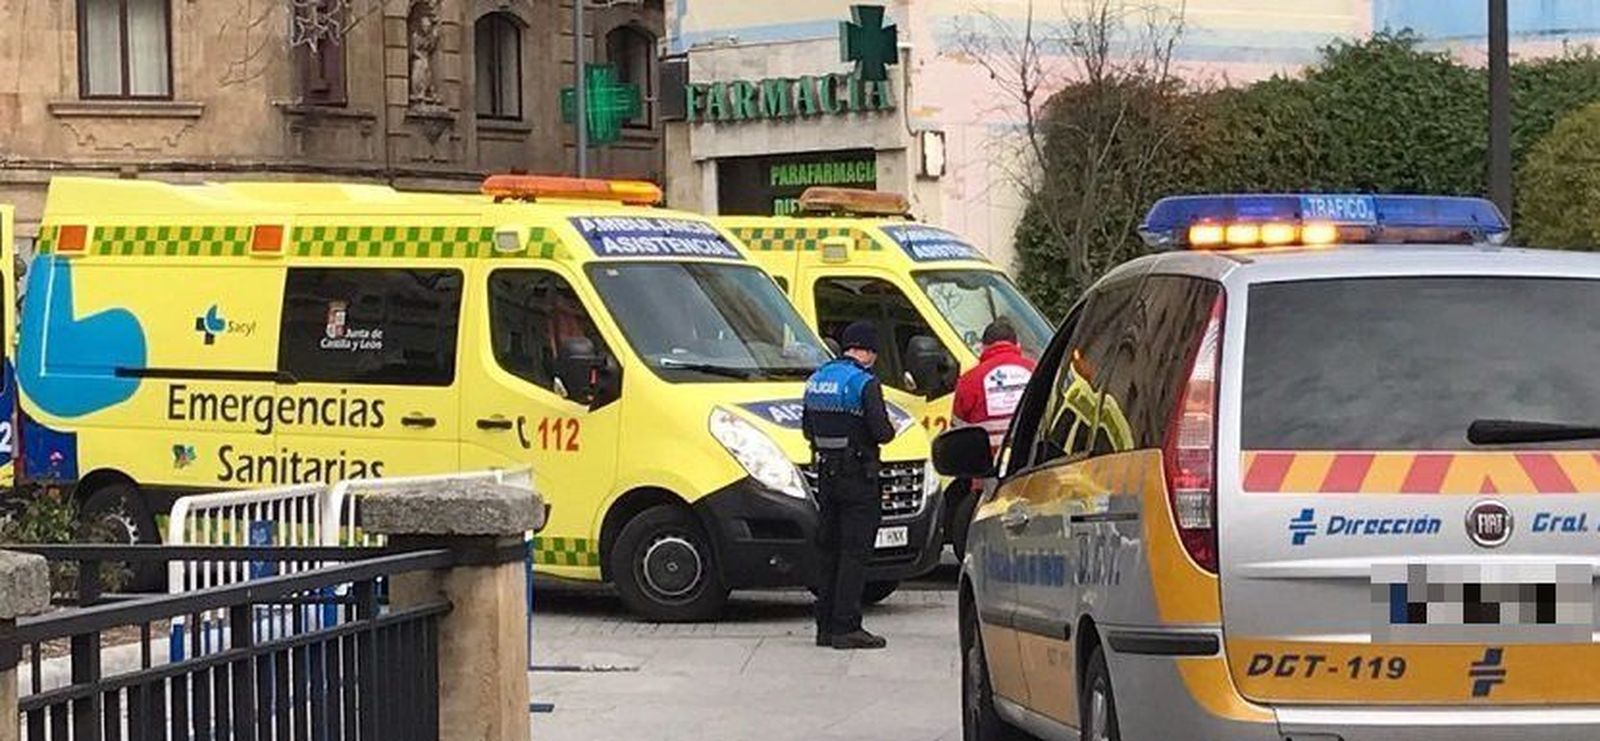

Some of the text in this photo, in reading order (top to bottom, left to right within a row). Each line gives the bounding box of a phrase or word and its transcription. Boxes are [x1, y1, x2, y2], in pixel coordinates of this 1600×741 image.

[167, 384, 385, 435] Emergencias
[538, 417, 580, 451] 112
[217, 445, 385, 484] Sanitarias
[1326, 513, 1442, 537] Dirección
[1477, 511, 1505, 536] FIAT
